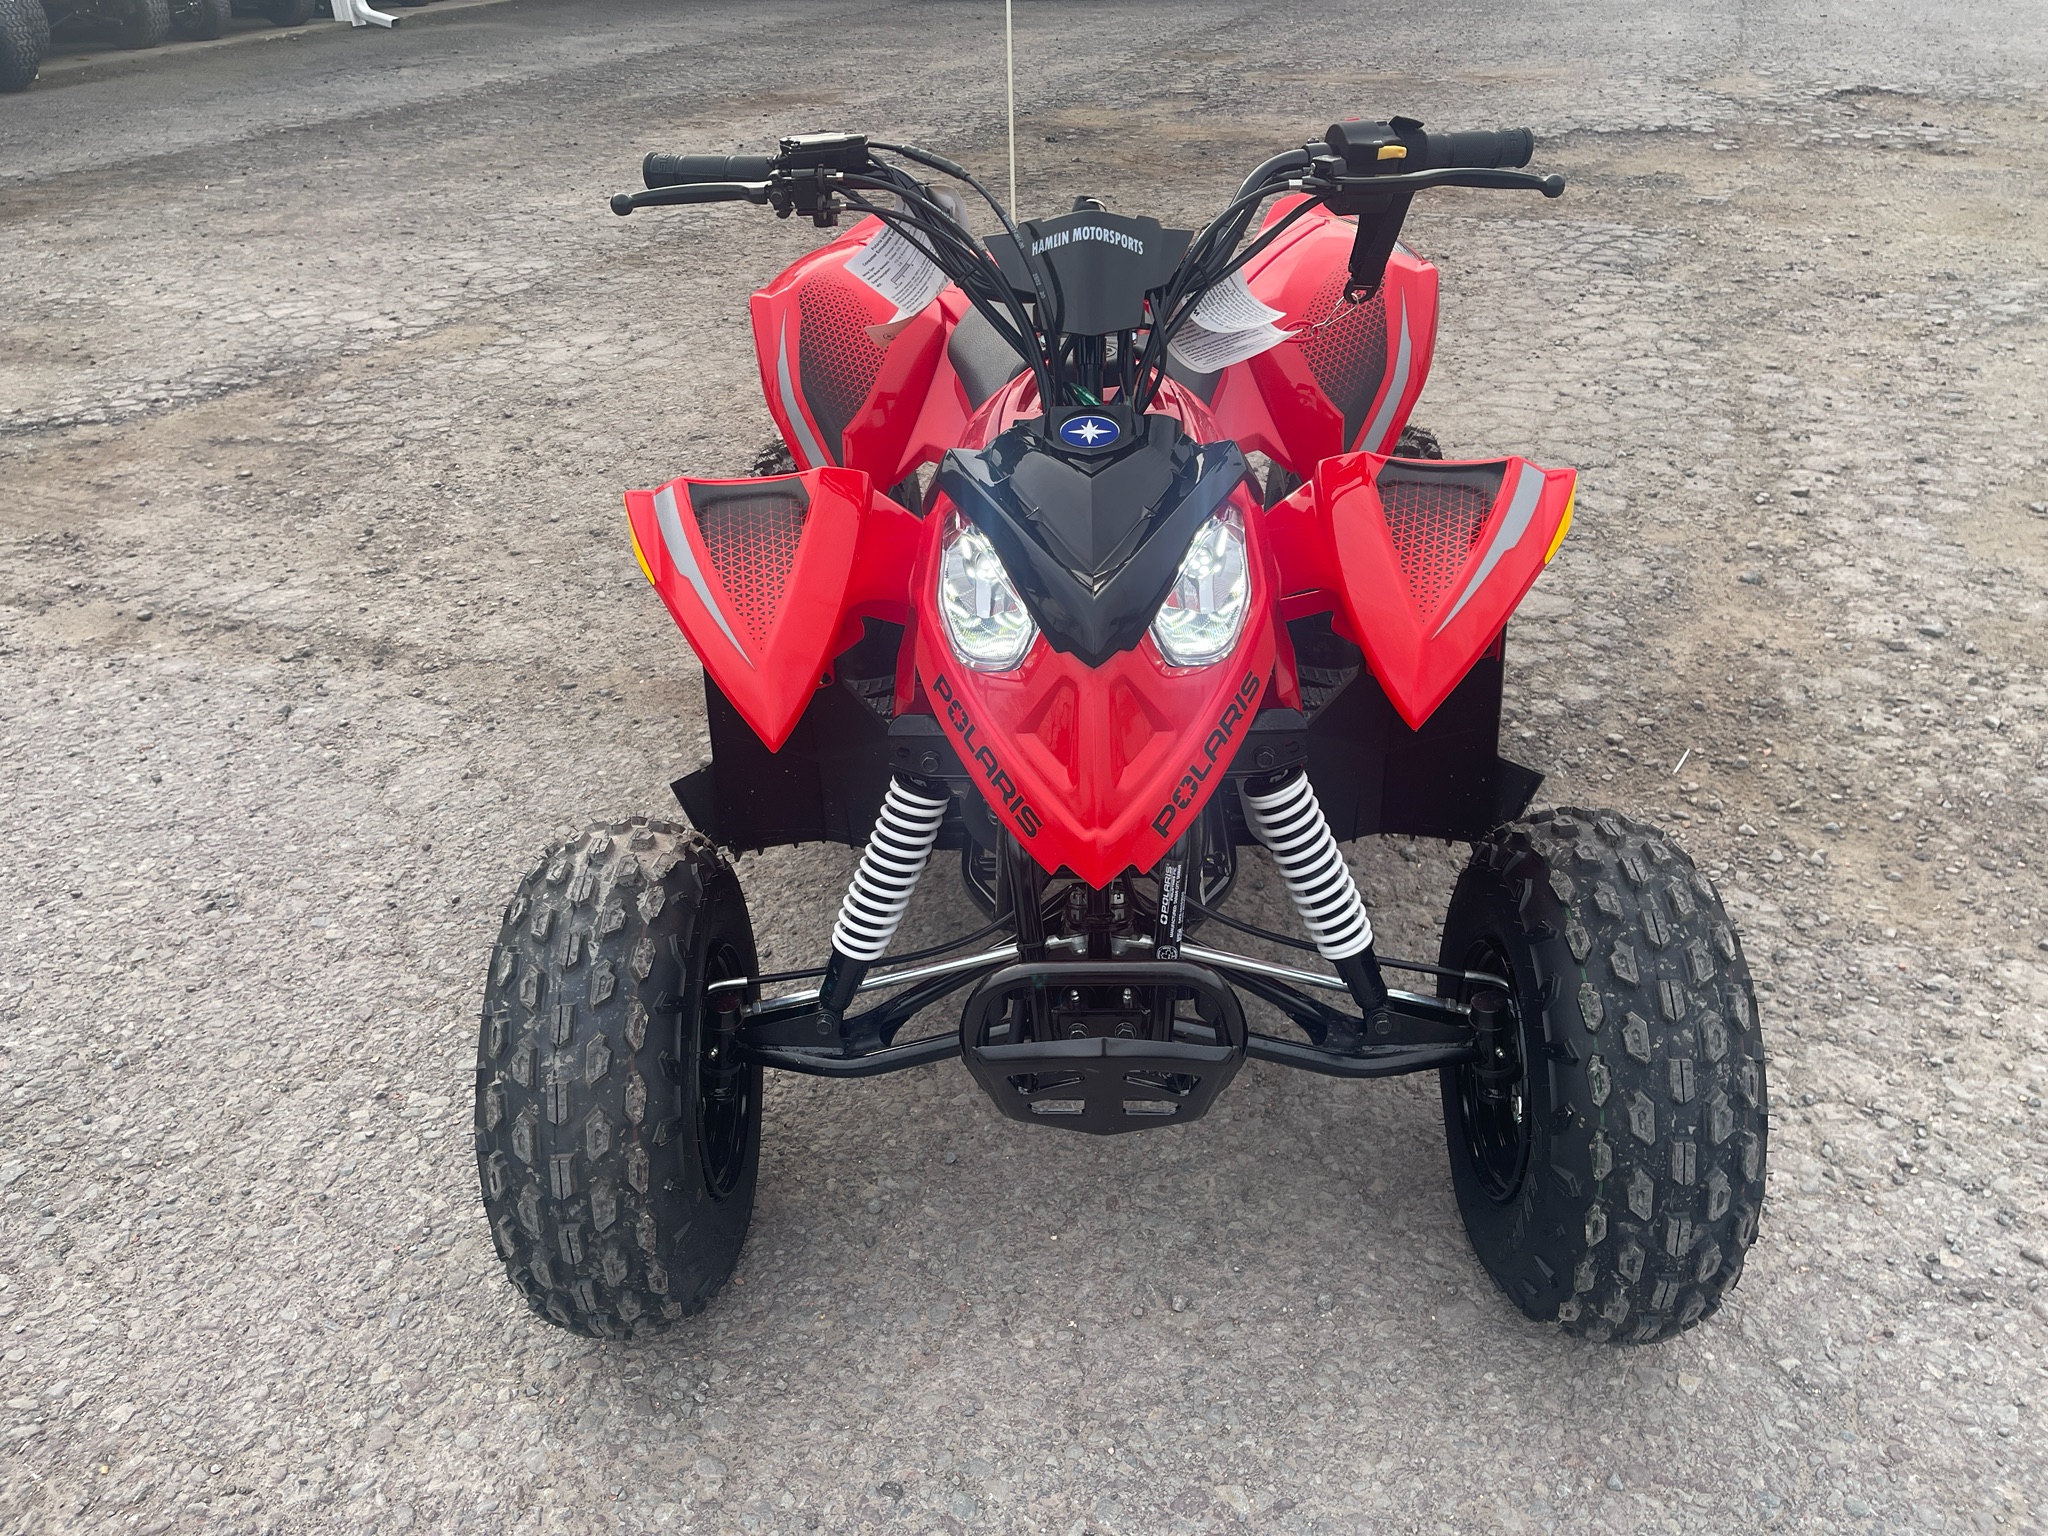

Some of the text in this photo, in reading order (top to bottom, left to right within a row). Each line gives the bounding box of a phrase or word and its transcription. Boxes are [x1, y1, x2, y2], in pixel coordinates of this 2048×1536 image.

[1031, 230, 1070, 257] HAMLIN
[1072, 226, 1144, 255] MOTORSPORTS
[932, 673, 1043, 838] POLARIS
[1151, 671, 1261, 839] POLARIS
[1161, 865, 1173, 914] POLARIS
